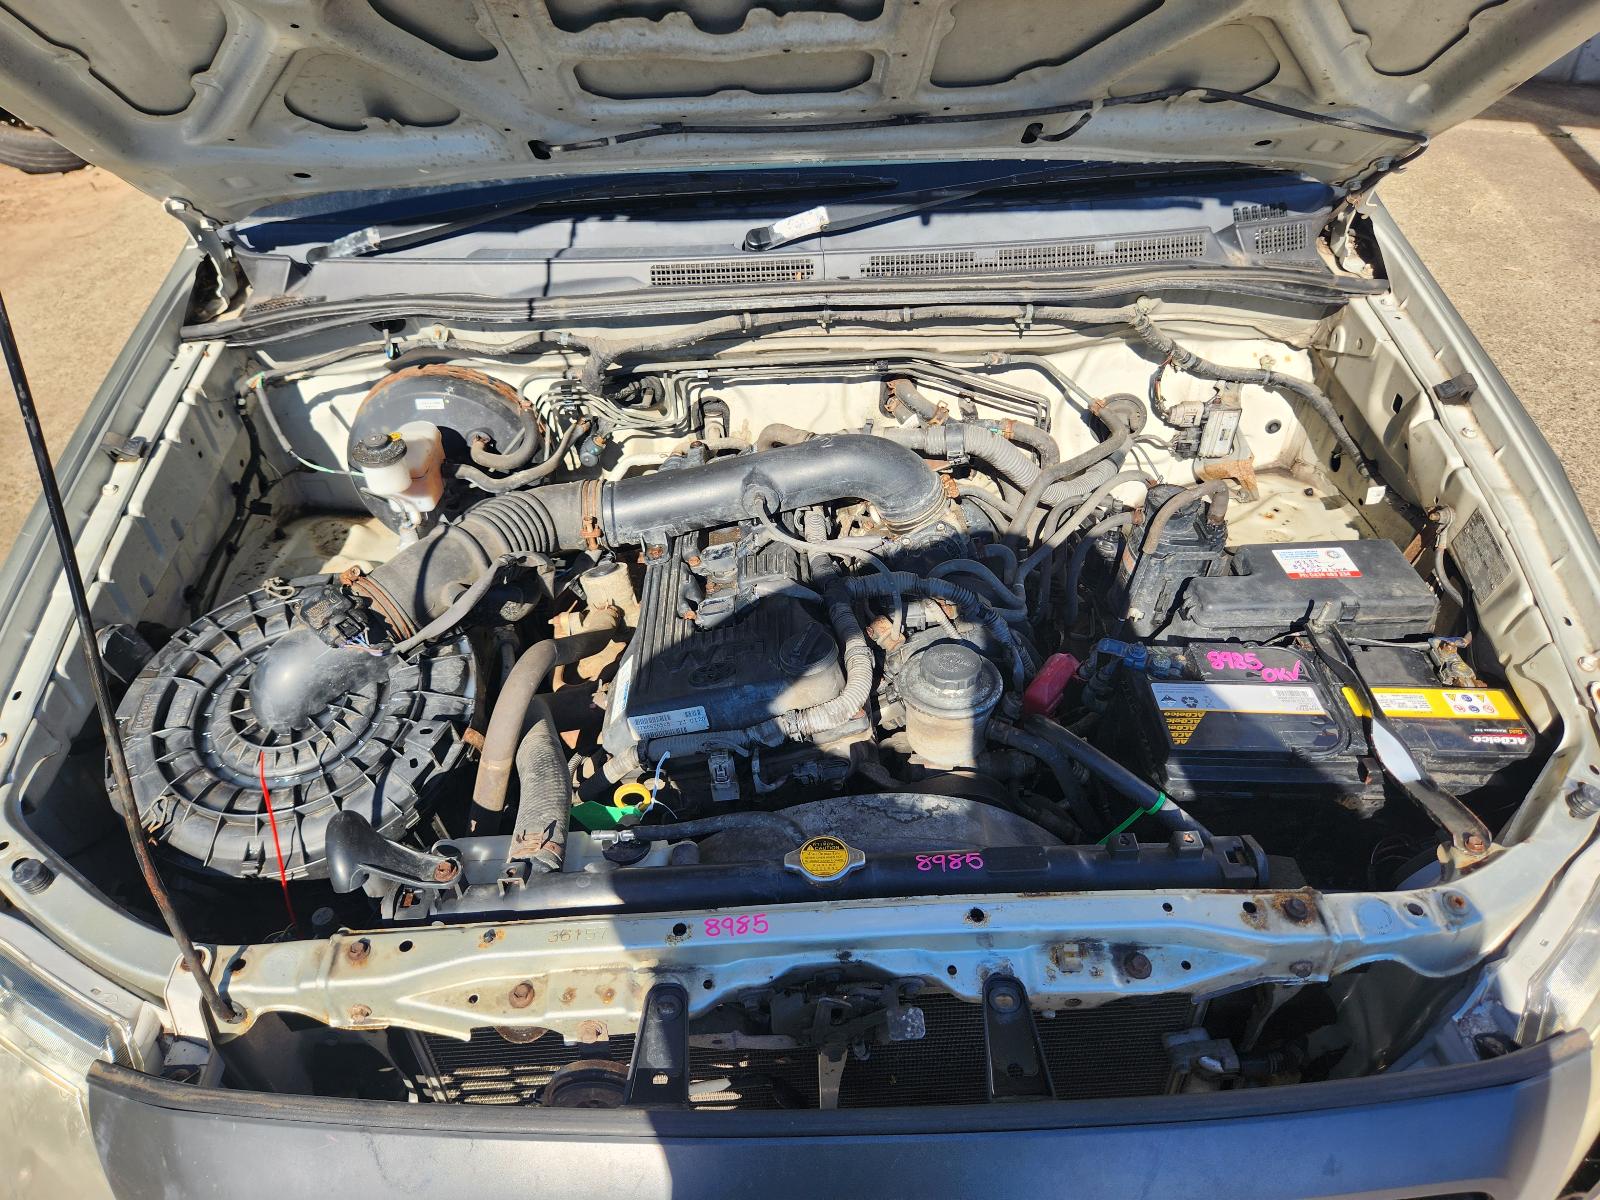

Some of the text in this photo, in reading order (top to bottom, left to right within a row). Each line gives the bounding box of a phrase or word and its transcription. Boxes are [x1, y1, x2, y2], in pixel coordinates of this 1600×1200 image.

[1207, 650, 1264, 670] 8985
[1472, 736, 1526, 745] ACDelco
[915, 852, 985, 872] 8985
[704, 913, 769, 937] 8985
